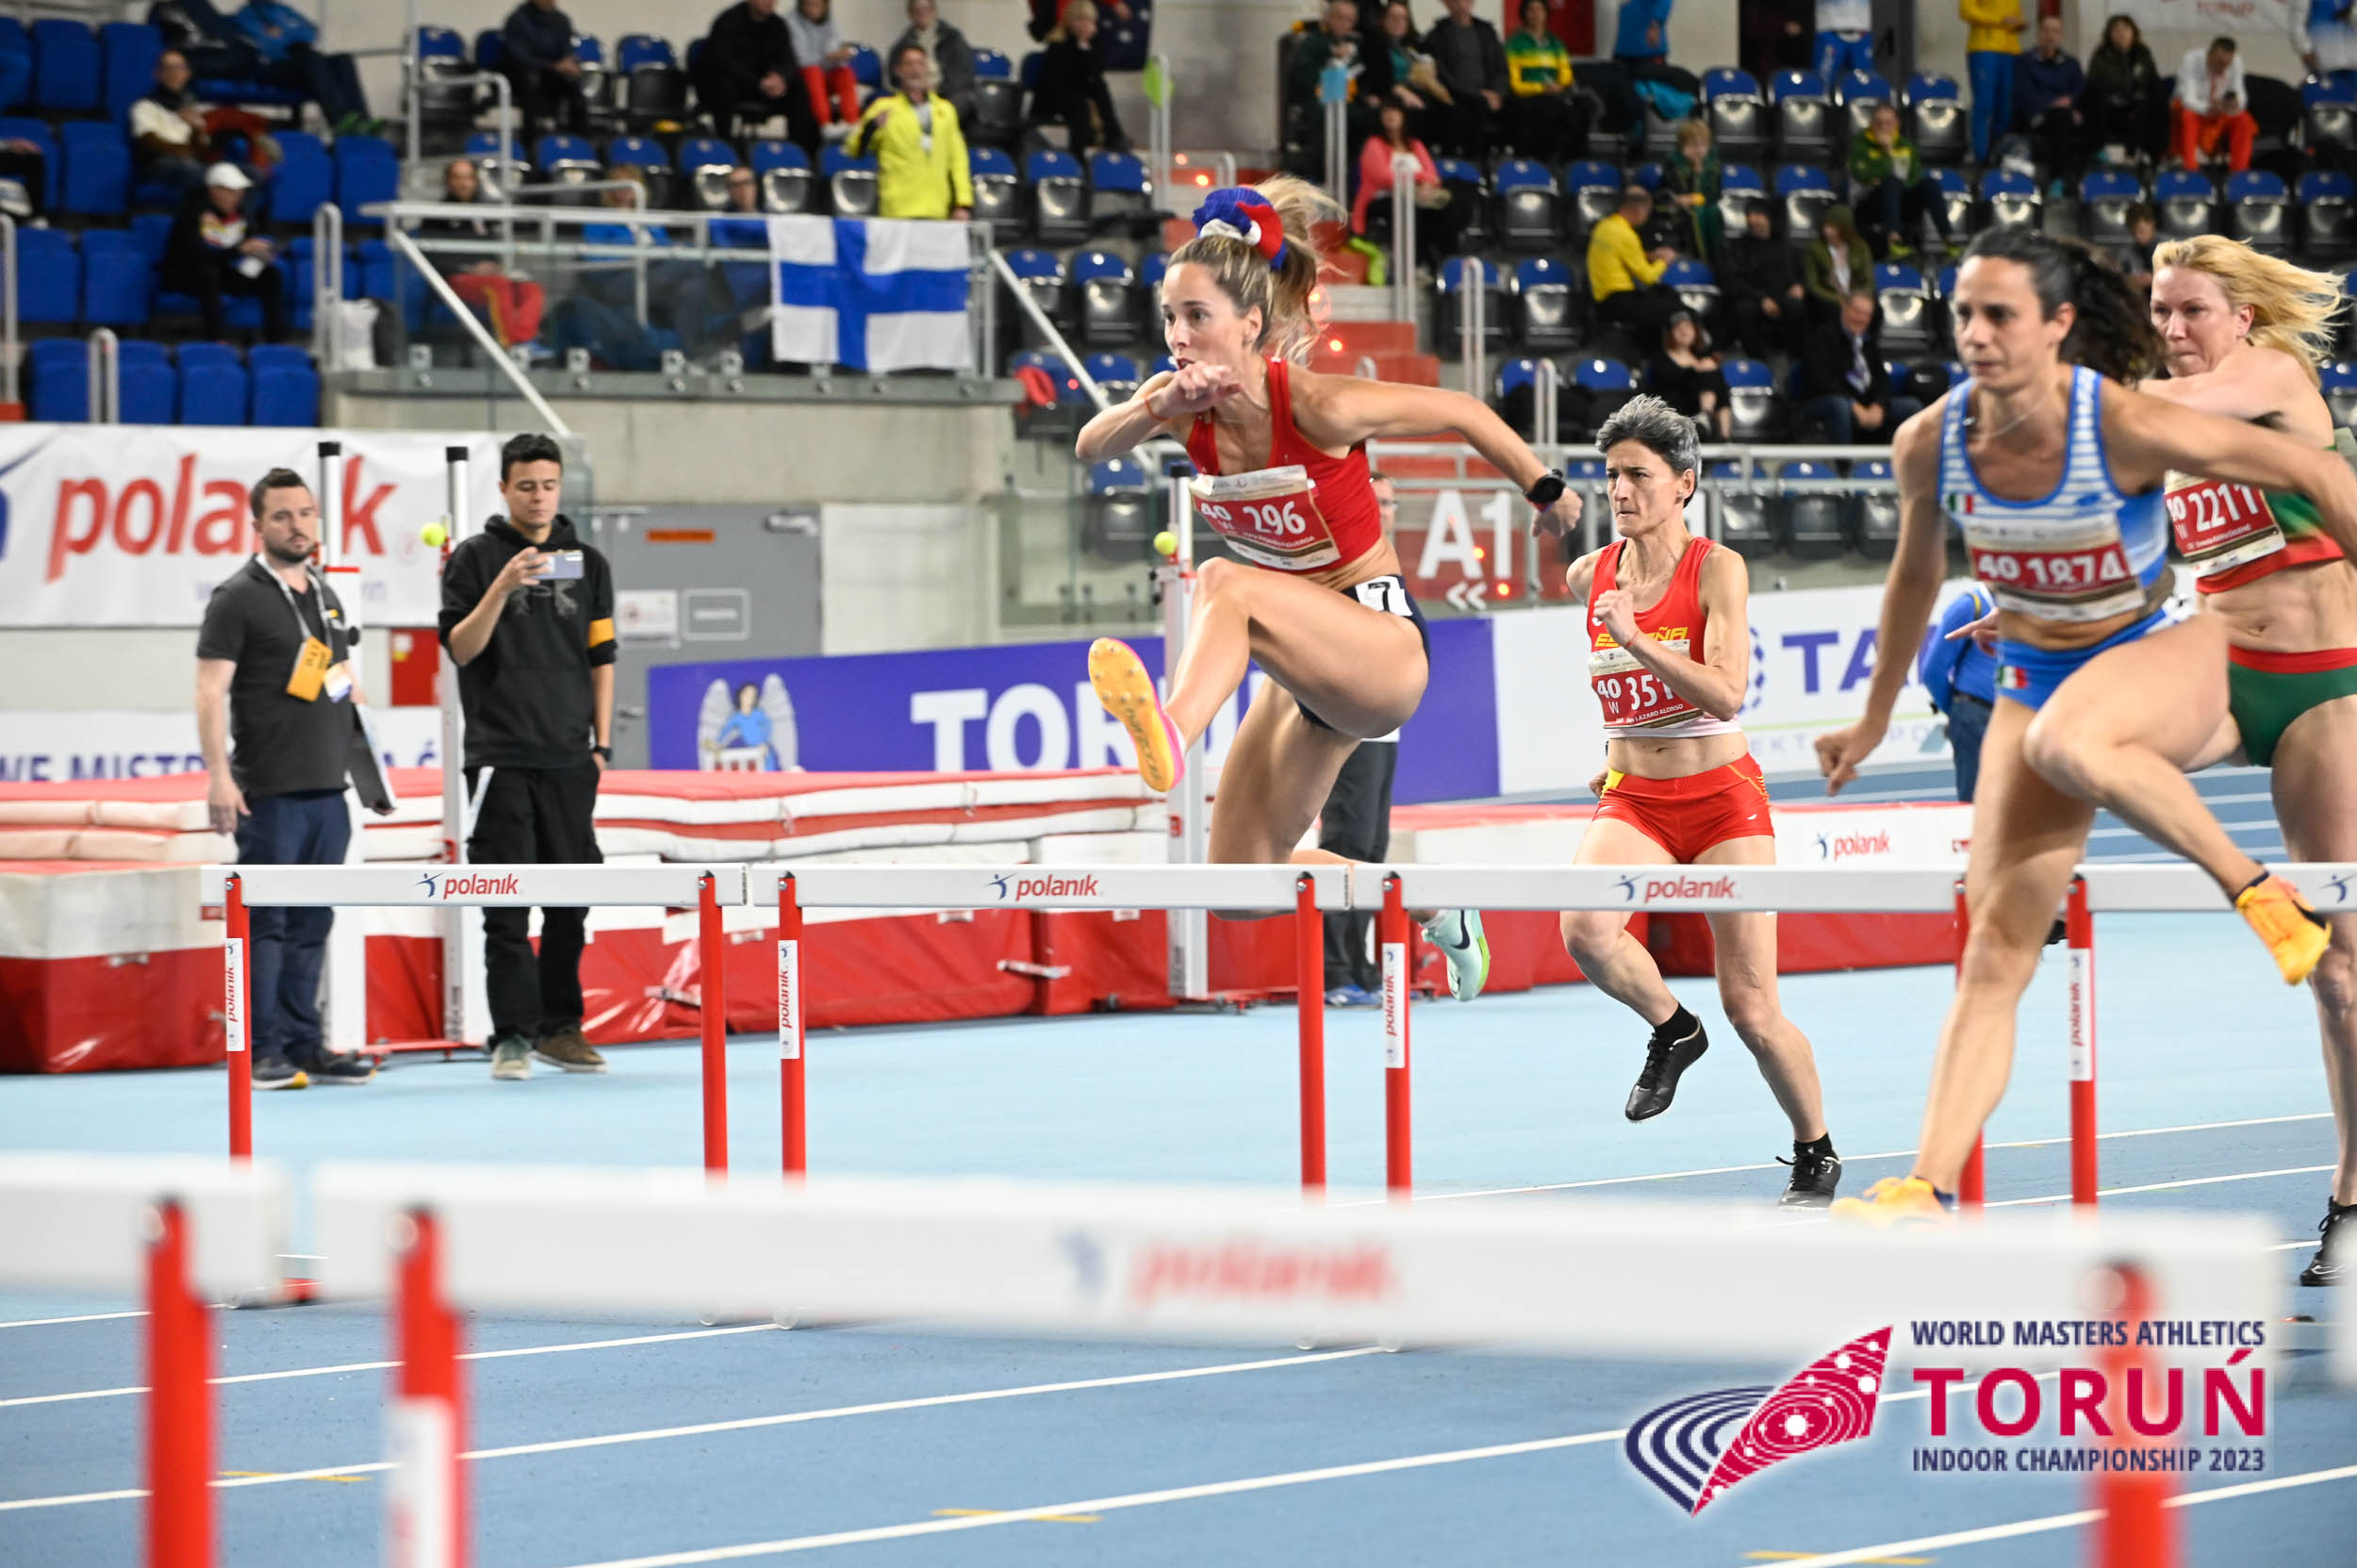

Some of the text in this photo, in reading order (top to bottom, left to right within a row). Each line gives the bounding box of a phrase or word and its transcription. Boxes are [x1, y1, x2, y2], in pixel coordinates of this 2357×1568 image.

[45, 454, 398, 585] polak
[1200, 501, 1306, 536] 40 296
[2187, 483, 2259, 533] 2211
[1417, 489, 1512, 580] A1
[1978, 553, 2019, 581] 40
[2025, 549, 2127, 586] 1874
[1367, 581, 1391, 612] 7
[1597, 678, 1622, 699] 40
[1607, 701, 1620, 715] W
[1834, 831, 1890, 862] polanik
[443, 873, 519, 900] polanik
[1015, 874, 1098, 901] polanik
[1643, 876, 1737, 903] polanik
[225, 966, 239, 1023] polanik
[779, 968, 792, 1030] polanik
[1384, 973, 1396, 1037] polanik
